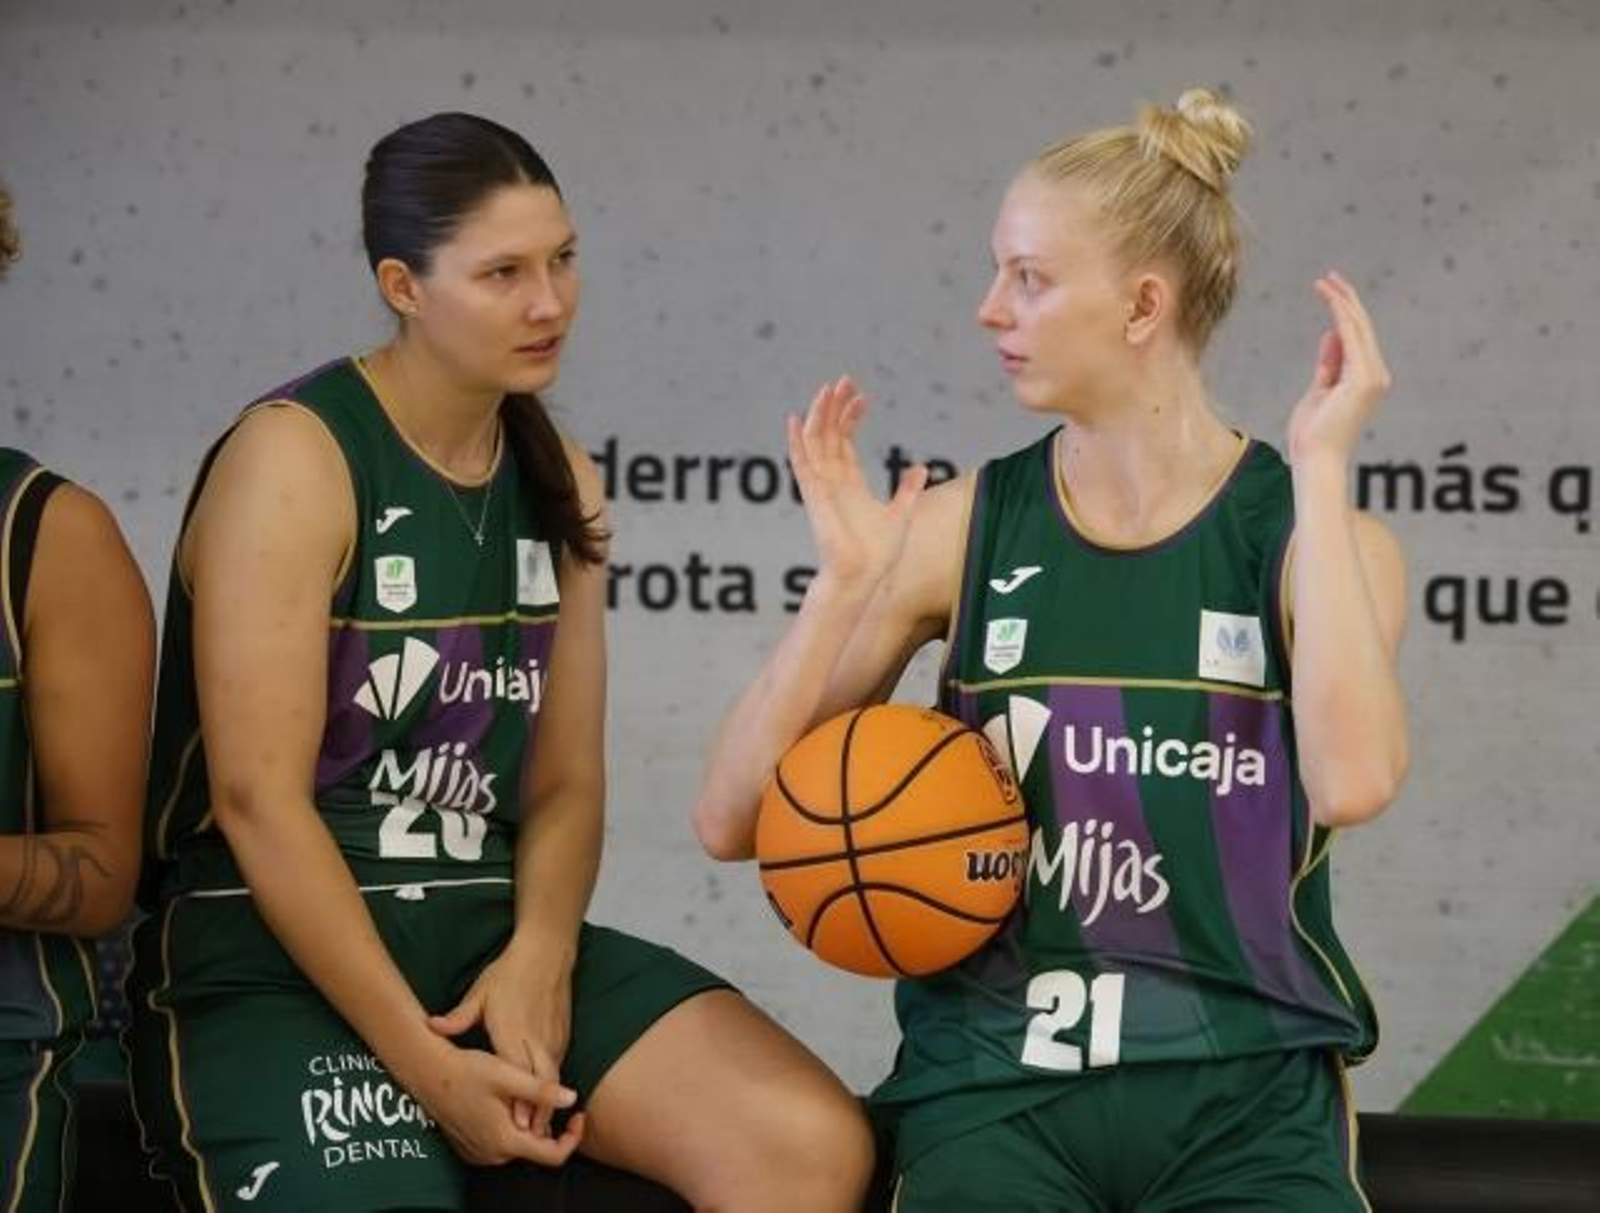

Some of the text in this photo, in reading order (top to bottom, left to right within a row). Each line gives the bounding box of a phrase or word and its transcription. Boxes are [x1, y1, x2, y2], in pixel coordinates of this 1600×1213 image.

[591, 436, 803, 503] derro
[1357, 443, 1520, 512] más
[607, 553, 756, 612] rota
[782, 567, 817, 612] s
[1425, 575, 1569, 642] que
[439, 657, 547, 713] Uniaj
[368, 741, 498, 815] Mijas
[1064, 724, 1266, 797] Unicaja
[1027, 819, 1170, 927] Mijas
[1020, 969, 1125, 1071] 21
[324, 1139, 428, 1168] DENTAL
